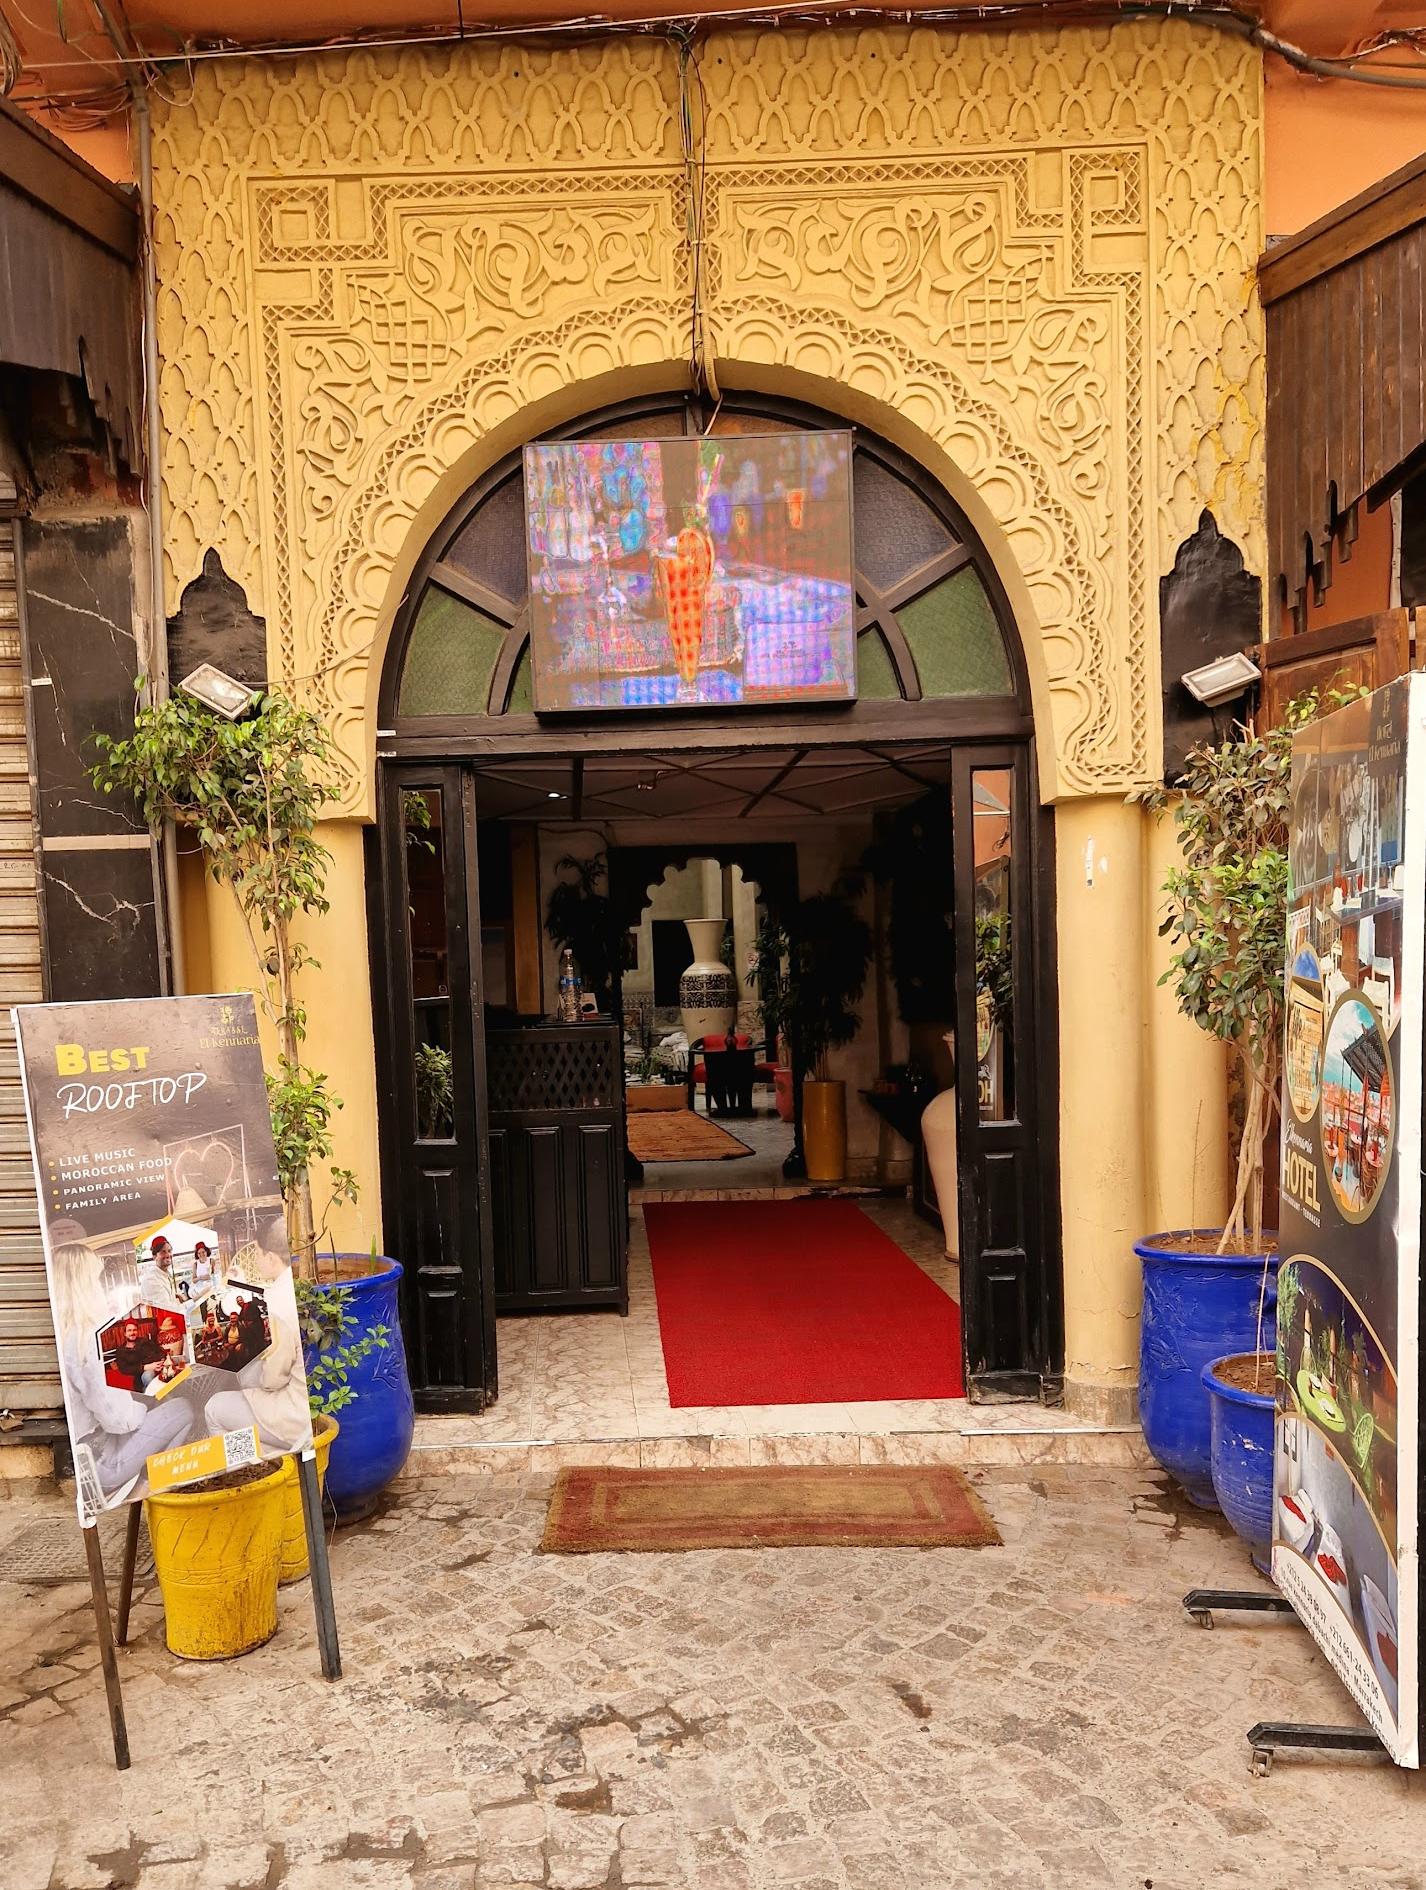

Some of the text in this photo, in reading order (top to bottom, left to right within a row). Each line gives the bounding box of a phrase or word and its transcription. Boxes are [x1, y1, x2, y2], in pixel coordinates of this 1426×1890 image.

[57, 1073, 207, 1120] ROOFTOP
[59, 1148, 136, 1167] LIVE MUSIC
[61, 1157, 172, 1181] MOROCCAN FOOD
[63, 1174, 165, 1195] PANORAMIC VIEW
[1282, 1146, 1321, 1213] HOTEL
[65, 1191, 142, 1210] FAMILY AREA
[153, 1441, 211, 1467] CHECK OUR
[172, 1459, 200, 1475] MENU
[1354, 1673, 1383, 1725] Marrakech
